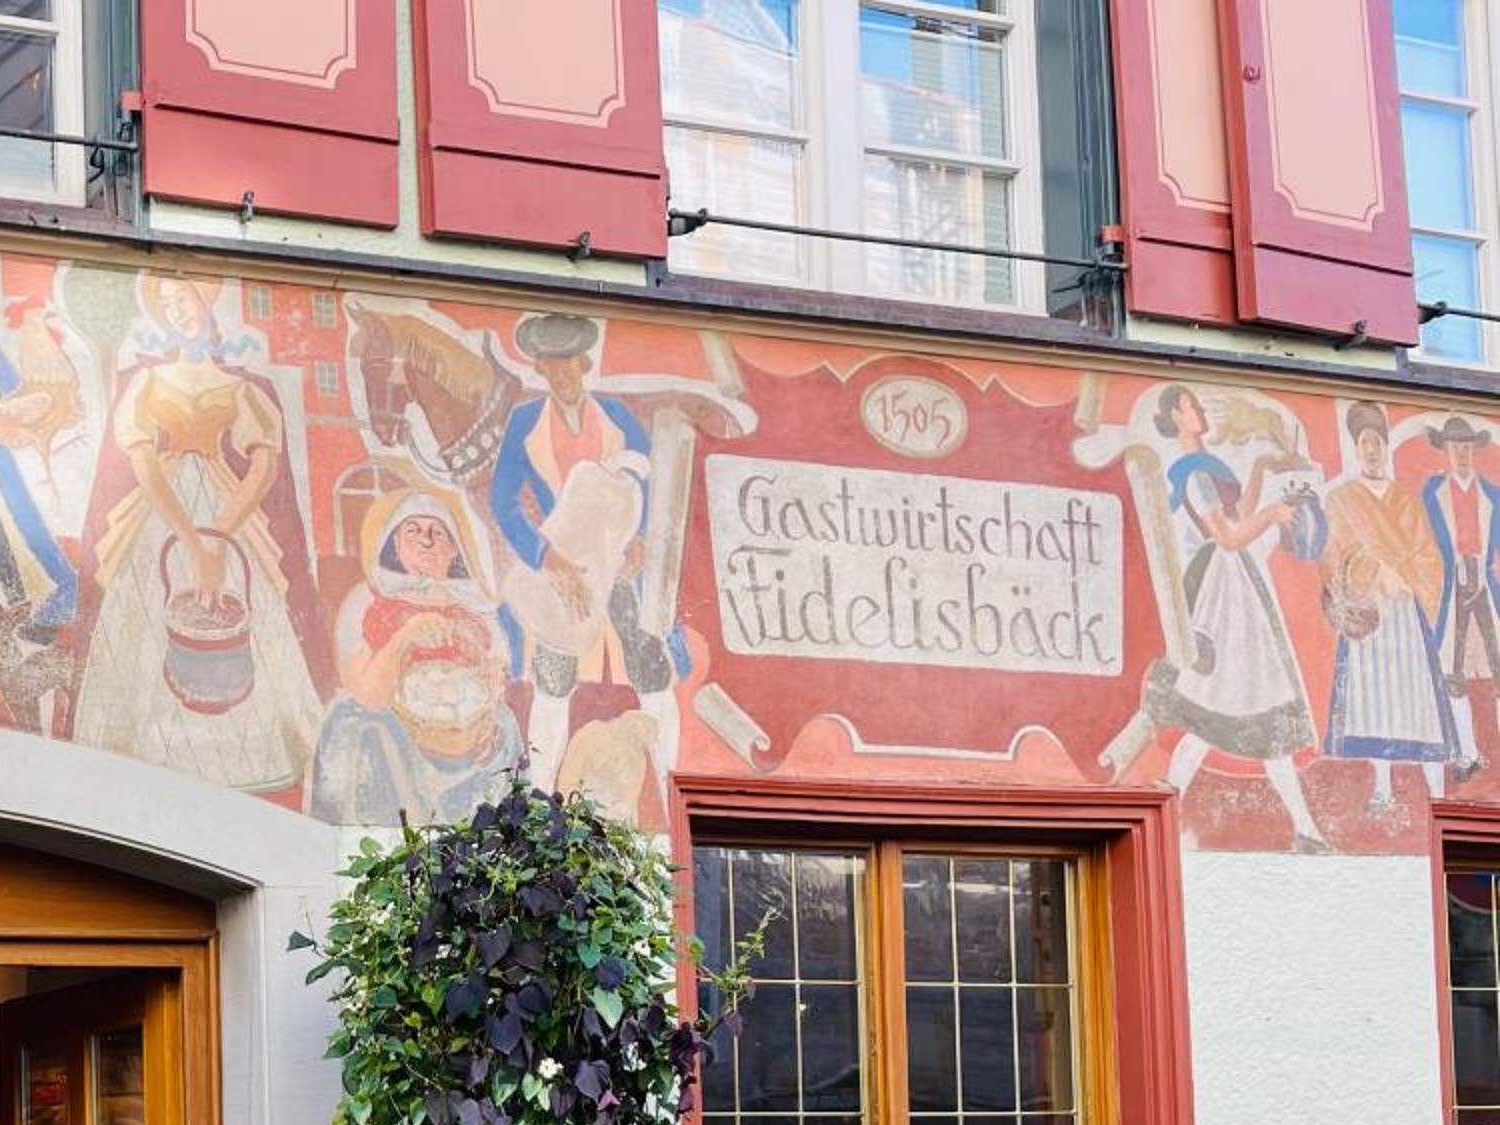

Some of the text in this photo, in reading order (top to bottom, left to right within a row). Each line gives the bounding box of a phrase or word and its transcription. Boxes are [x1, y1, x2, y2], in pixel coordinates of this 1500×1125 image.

[880, 390, 953, 448] 1505
[738, 474, 1103, 576] Gastwirtschaft
[725, 546, 1116, 664] Fidelisbäck
